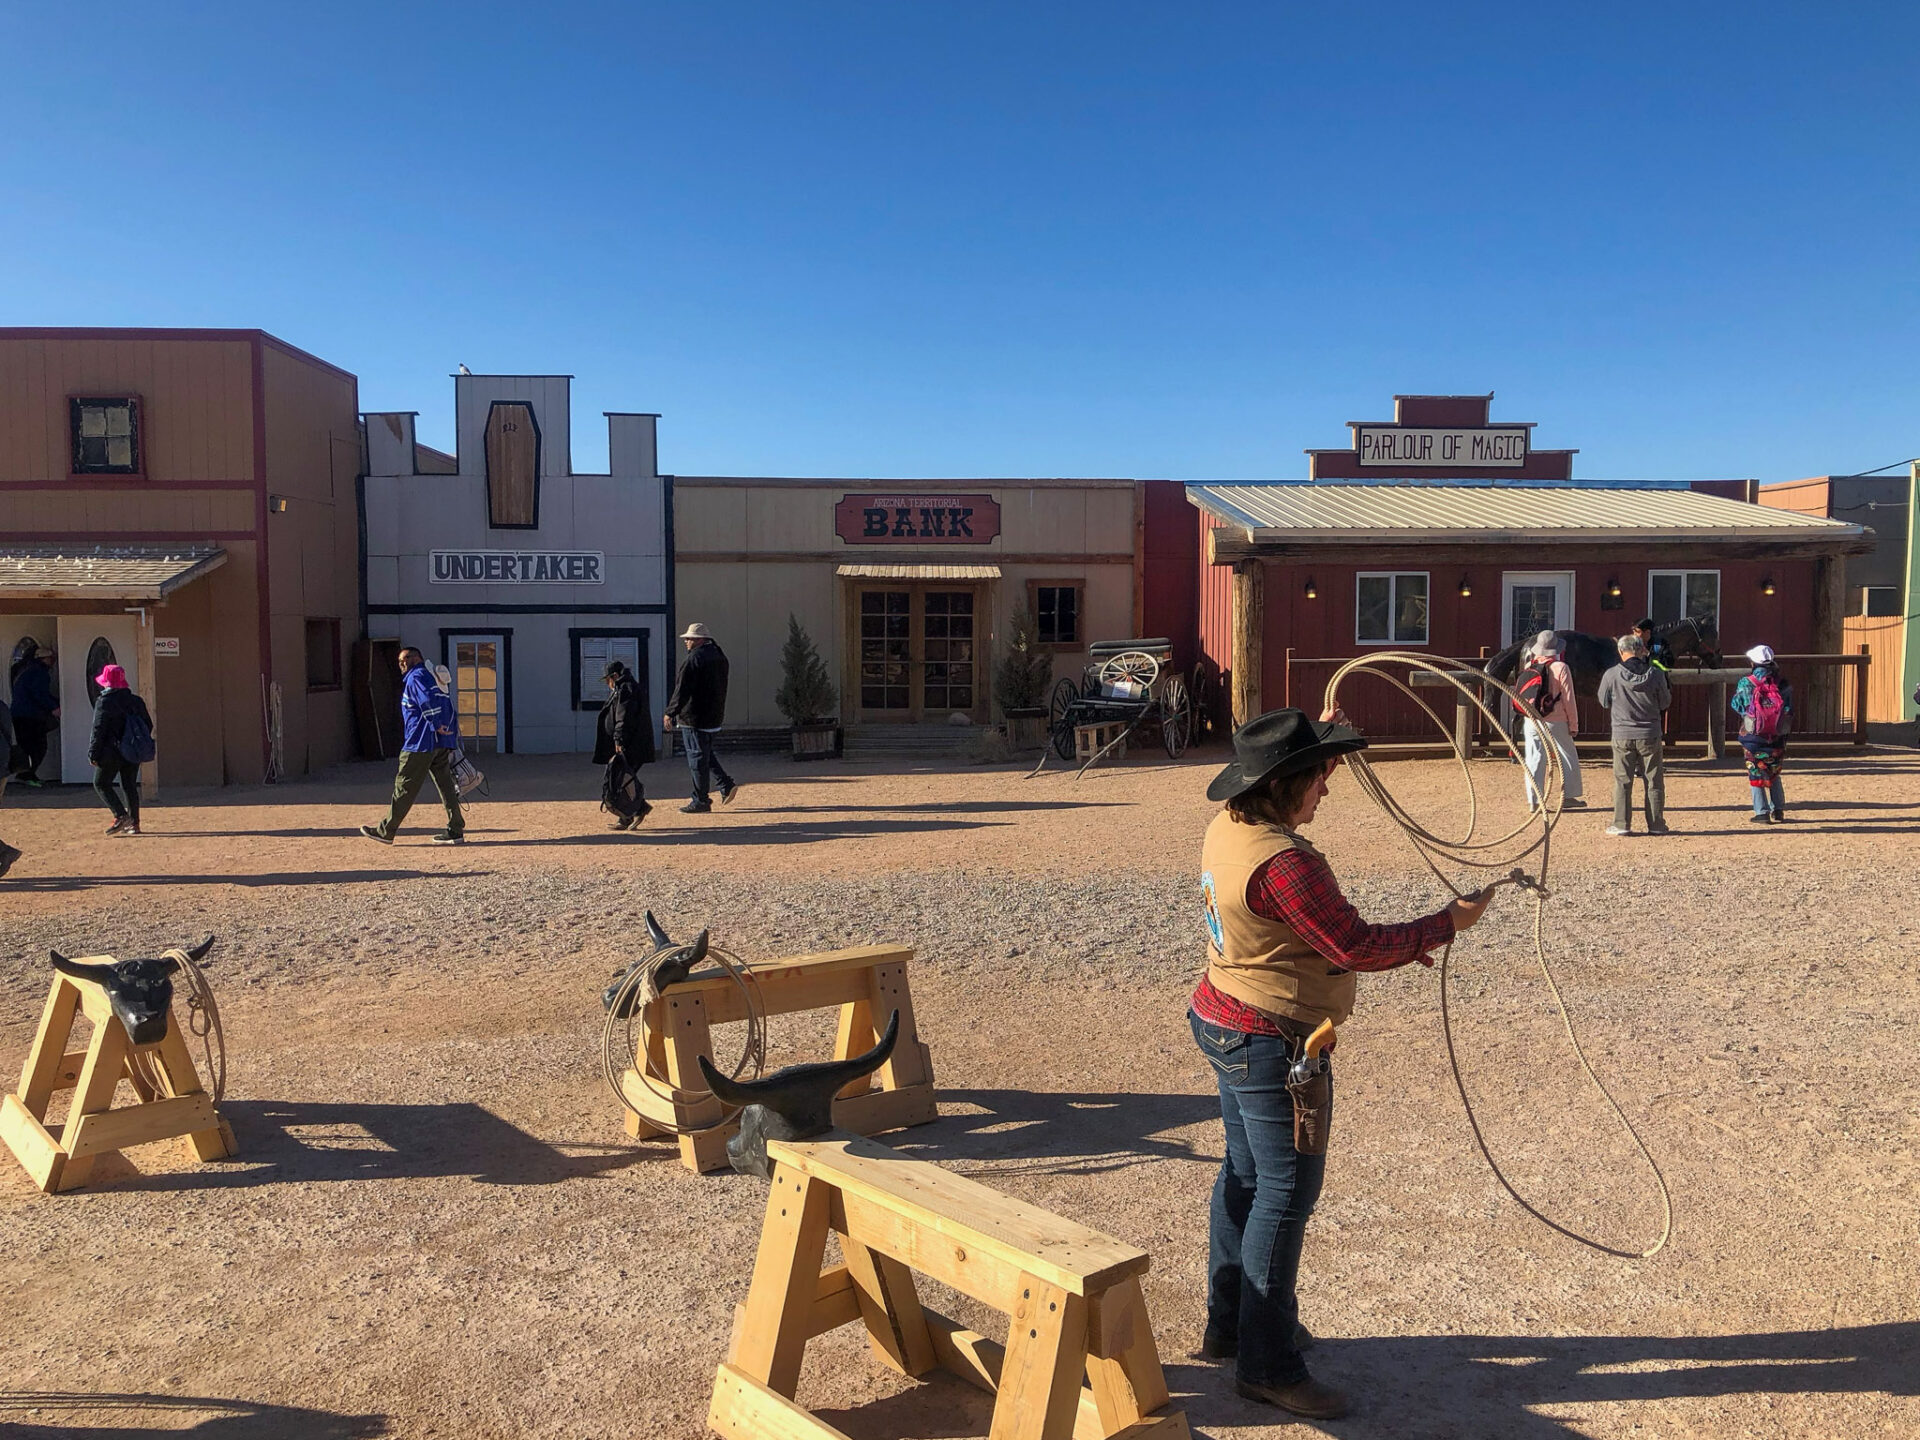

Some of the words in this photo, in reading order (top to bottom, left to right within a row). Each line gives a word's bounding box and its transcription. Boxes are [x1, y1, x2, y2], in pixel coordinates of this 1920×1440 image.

[1362, 434, 1433, 460] PARLOUR
[1442, 434, 1464, 460] OF
[1472, 435, 1524, 461] MAGIC
[873, 498, 906, 508] ARIZONA
[909, 498, 962, 508] TERRITORIAL
[863, 508, 974, 537] BANK
[434, 554, 600, 580] UNDERTAKER
